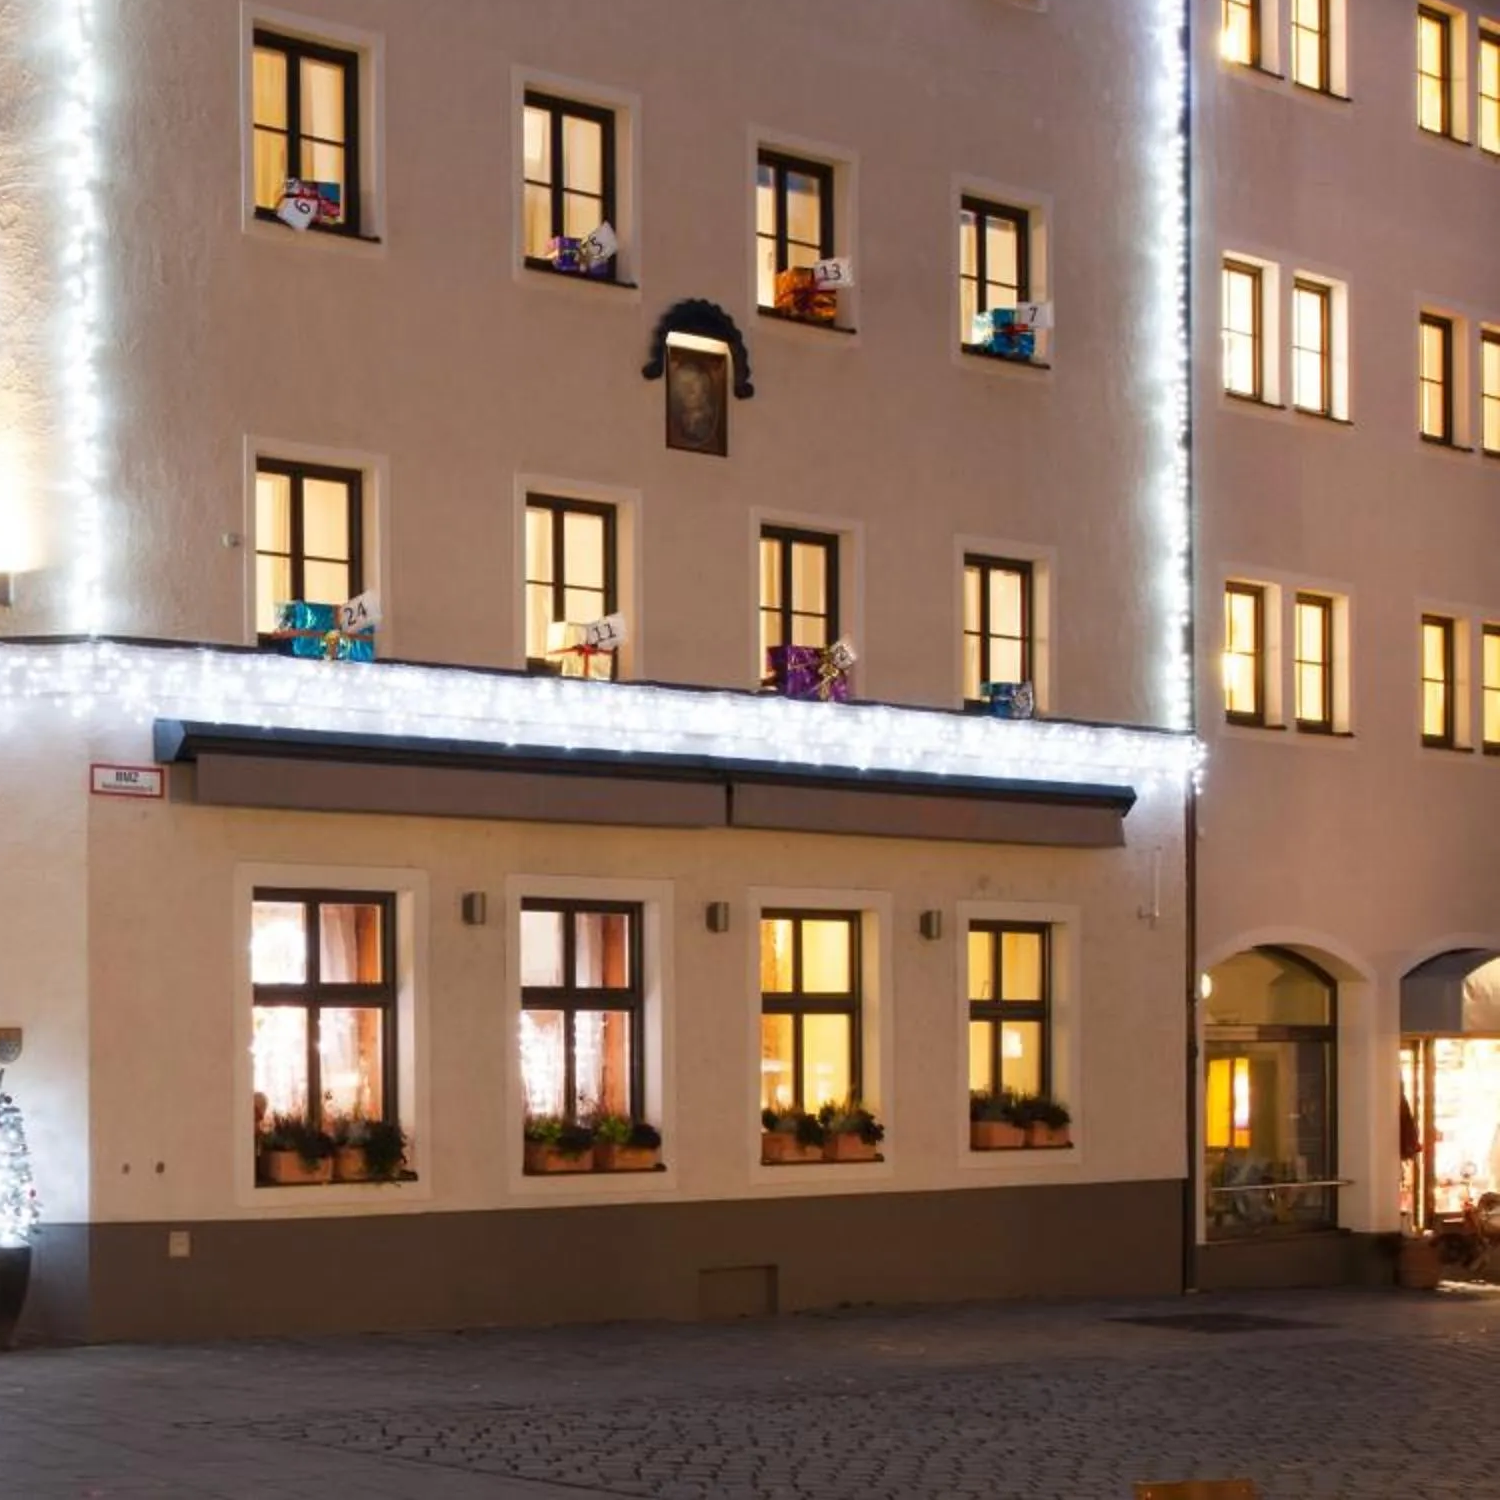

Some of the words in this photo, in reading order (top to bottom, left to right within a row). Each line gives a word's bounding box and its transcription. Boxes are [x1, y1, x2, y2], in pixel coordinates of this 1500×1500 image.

[819, 263, 842, 281] 13
[1028, 306, 1038, 322] 7
[344, 600, 368, 626] 24
[593, 621, 617, 642] 11
